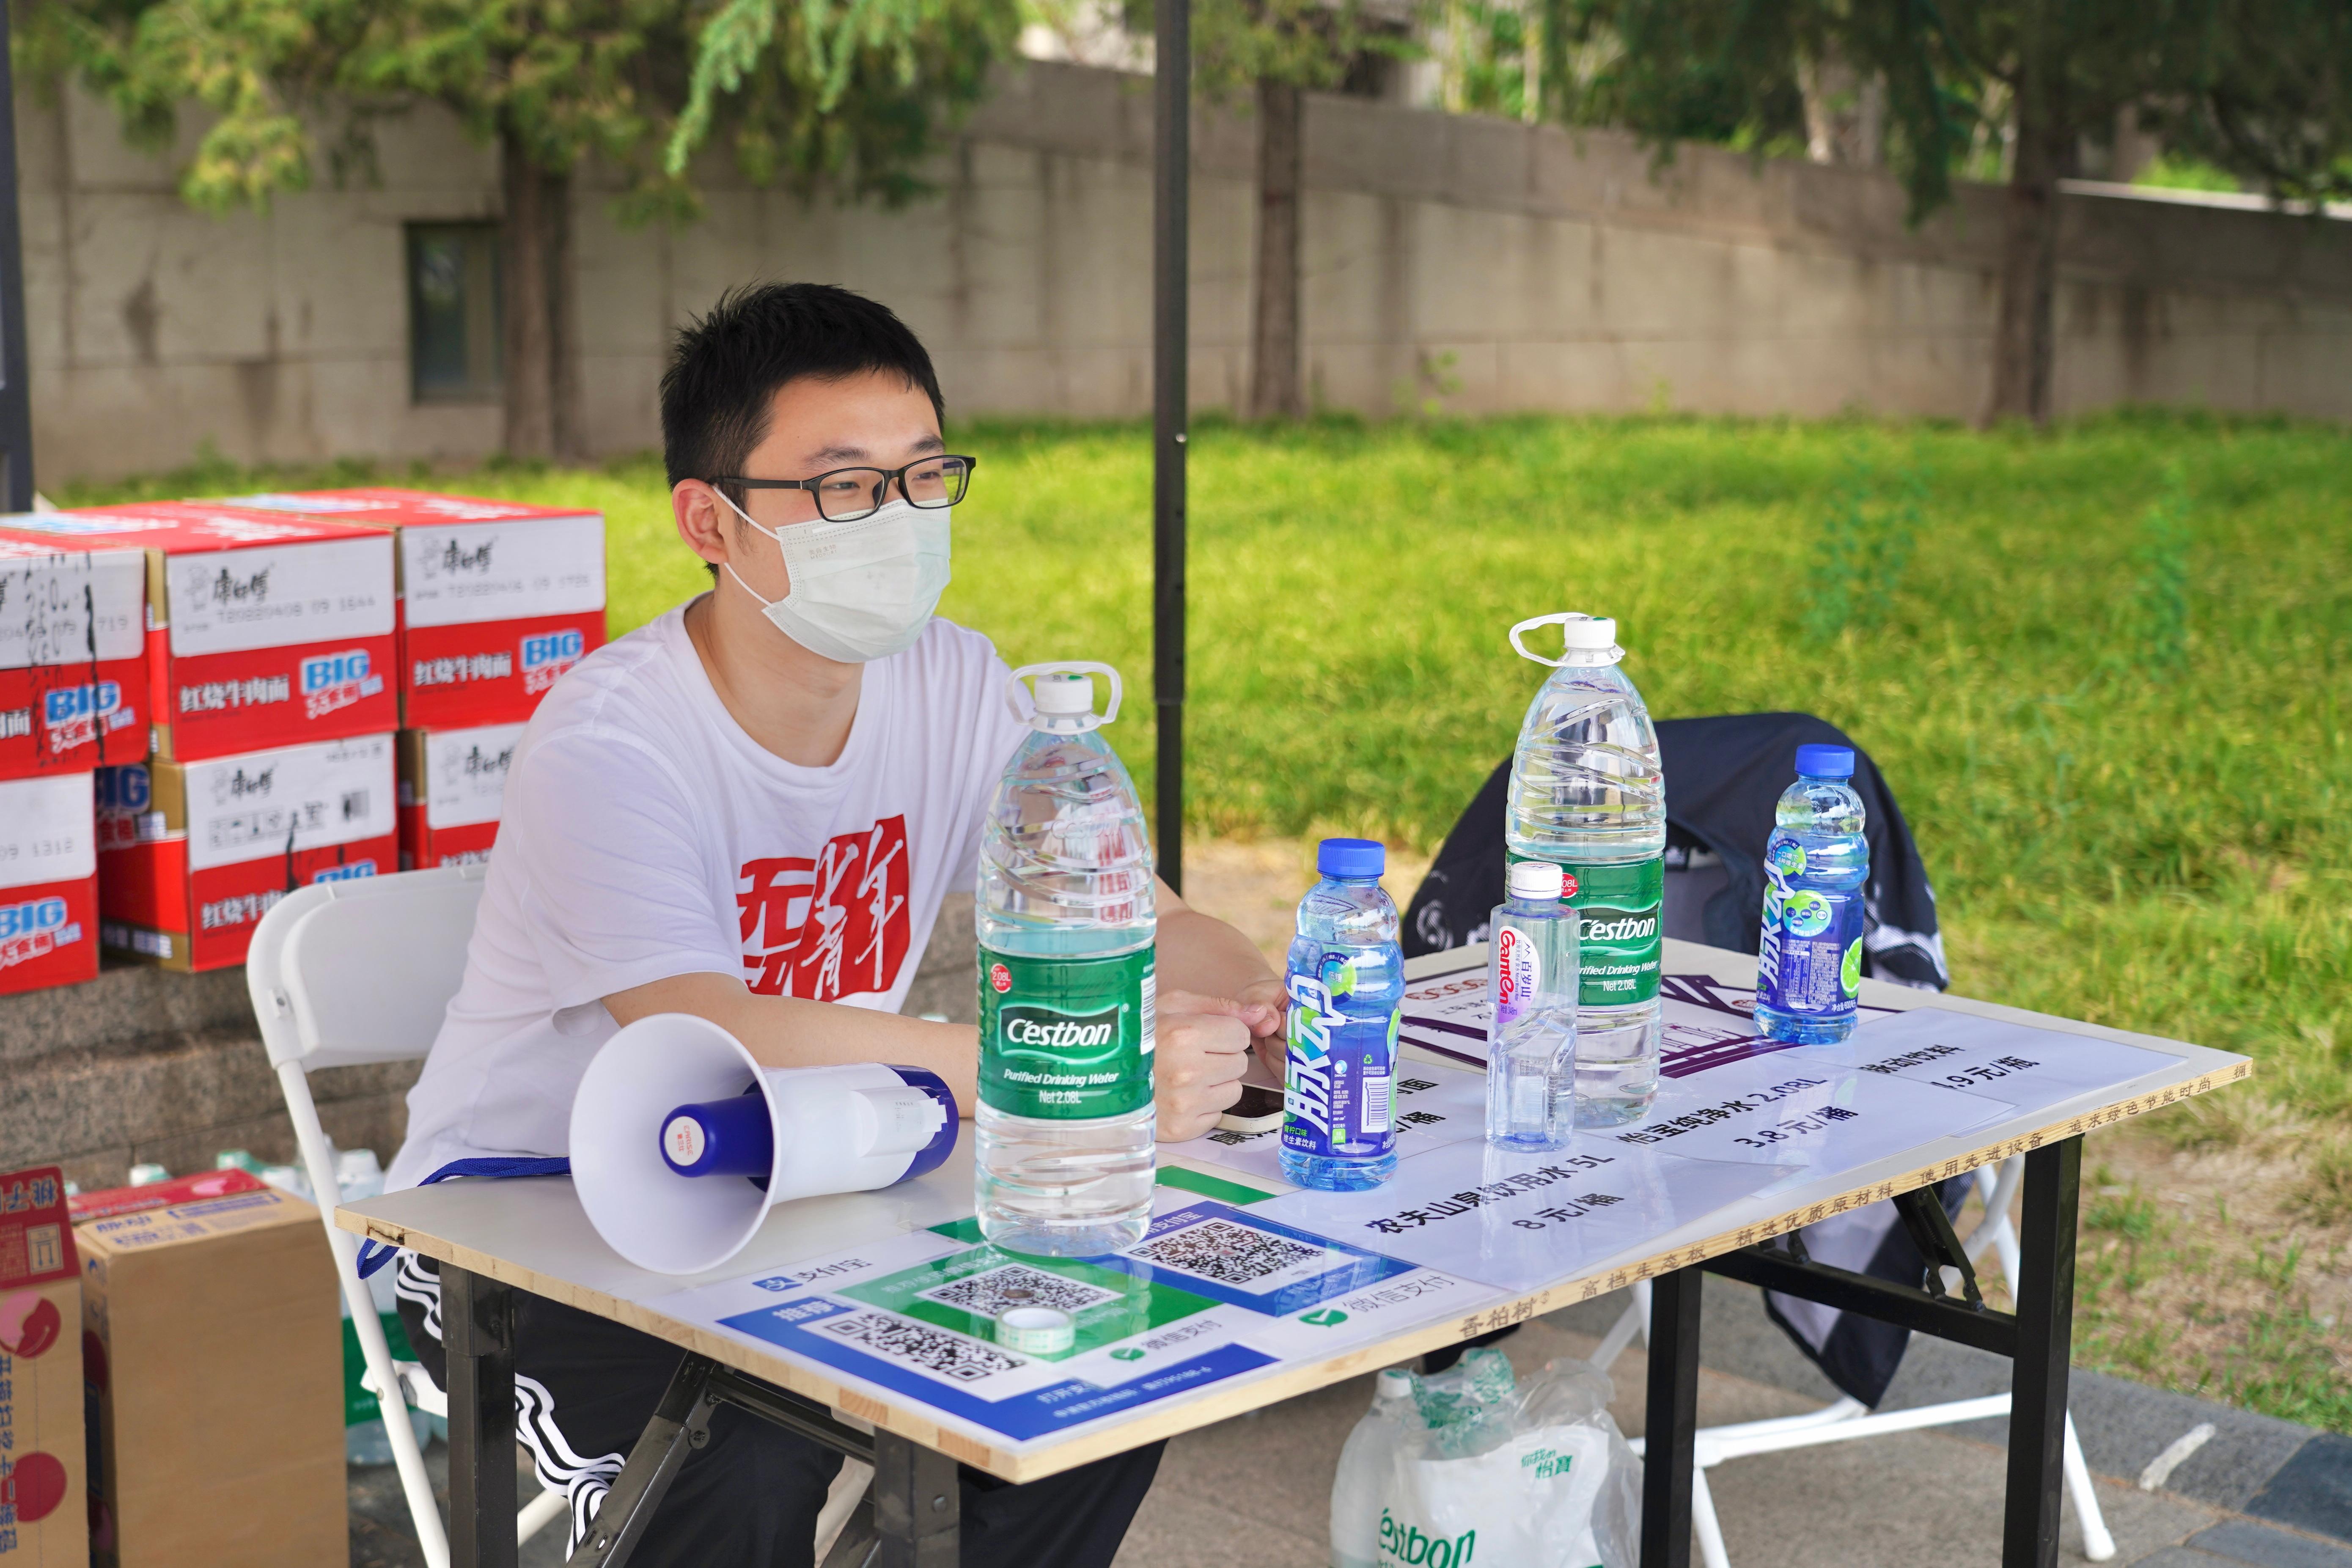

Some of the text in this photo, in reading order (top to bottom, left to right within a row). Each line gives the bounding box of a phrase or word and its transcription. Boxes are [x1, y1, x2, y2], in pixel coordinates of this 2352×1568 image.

[526, 631, 583, 667] BIG
[306, 654, 369, 691] BIG
[47, 683, 118, 724] BIG
[180, 674, 291, 713] 红烧牛肉面
[1521, 961, 1532, 1000] 百岁山
[1607, 963, 1640, 975] Drinking
[1641, 960, 1657, 971] Water
[1603, 979, 1637, 992] Net 2.08L
[1007, 1019, 1111, 1047] C'estbon
[1003, 1068, 1119, 1087] Purified Drinking Water
[1039, 1090, 1082, 1104] Net 2.08L
[1283, 1134, 1316, 1150] 维生素饮料
[1919, 1132, 2044, 1186] 使用先进设备
[2067, 1076, 2212, 1135] 追求绿色节能时尚
[792, 1258, 873, 1282] 支付宝
[1342, 1274, 1456, 1314] 微信支付
[1145, 1318, 1223, 1351] 微信支付
